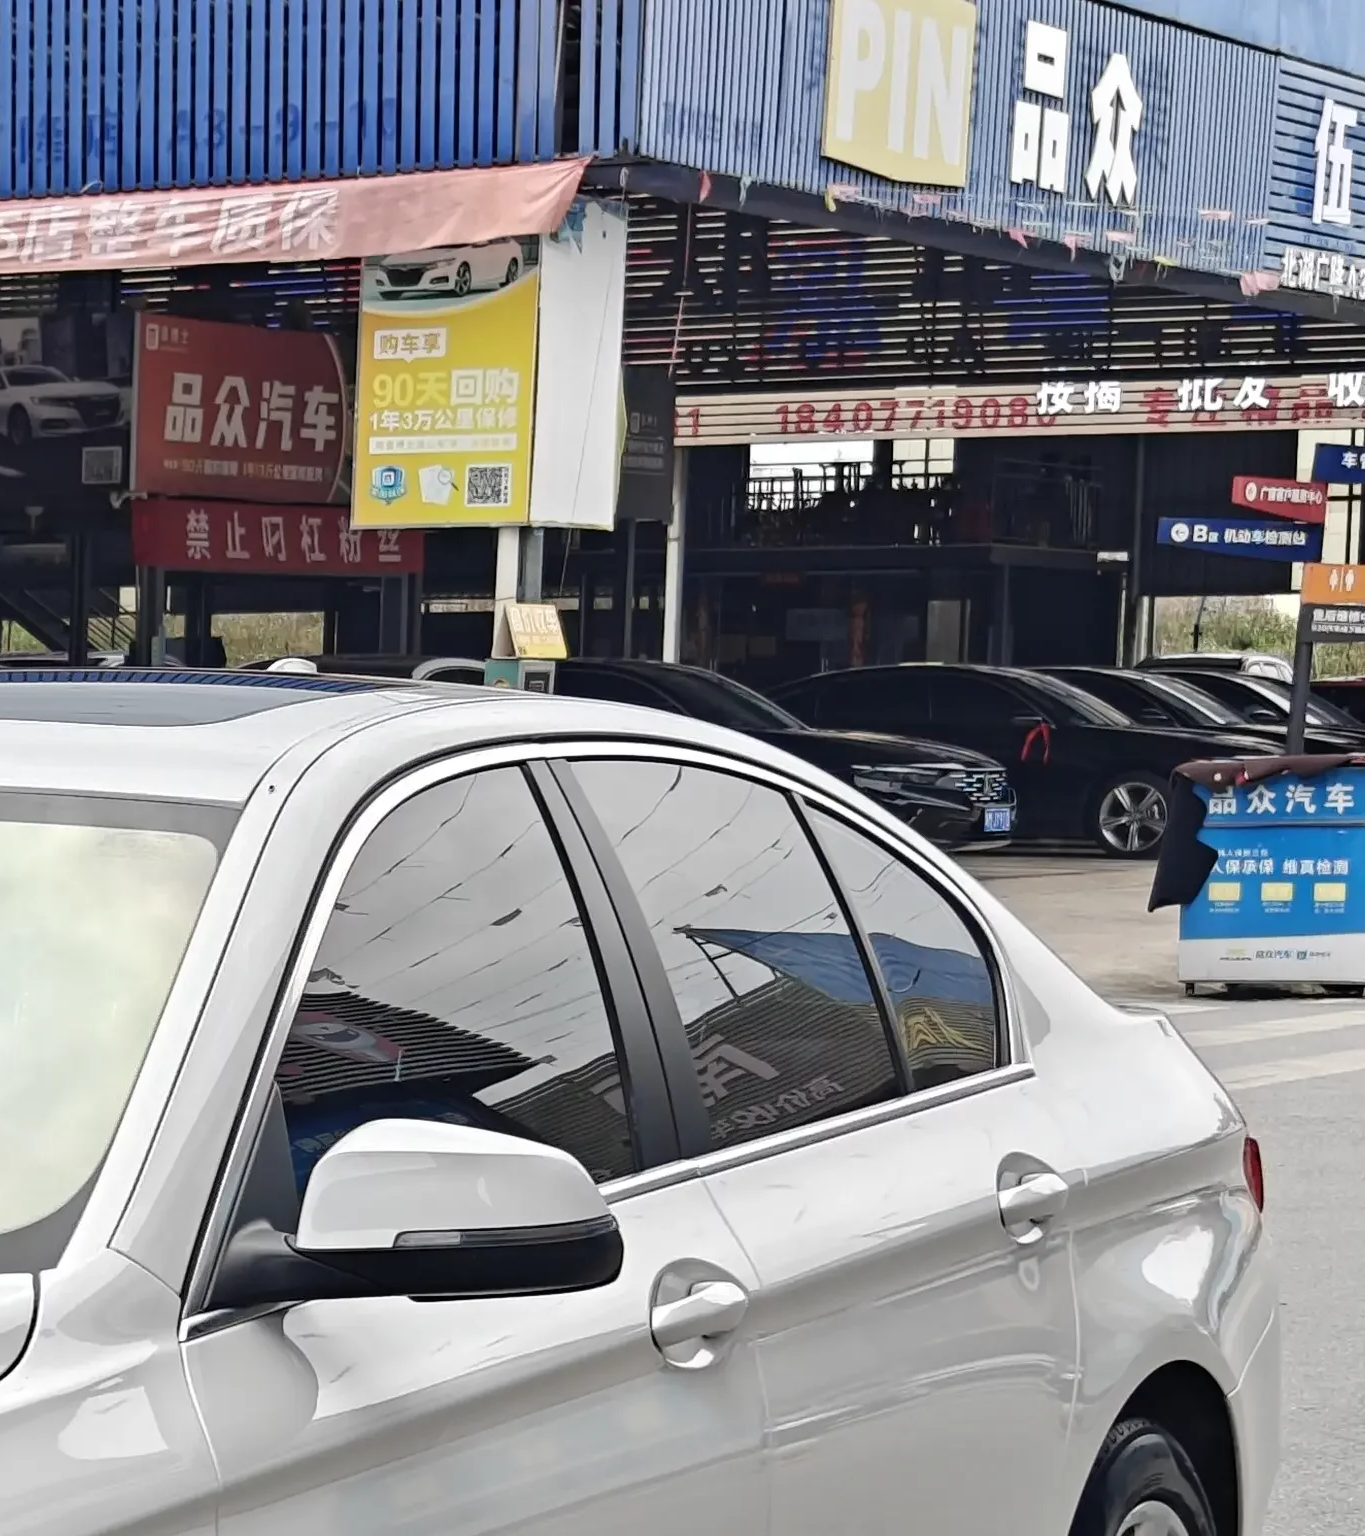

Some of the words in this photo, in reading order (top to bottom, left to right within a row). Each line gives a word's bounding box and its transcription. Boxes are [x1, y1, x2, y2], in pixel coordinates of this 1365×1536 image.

[834, 4, 969, 166] PIN
[1010, 19, 1144, 205] 品众
[379, 331, 441, 355] 购车享
[372, 367, 520, 408] 90天回购
[163, 371, 340, 452] 品众汽车
[369, 405, 518, 433] 1年3万公里保修
[1208, 783, 1355, 815] 品众汽车
